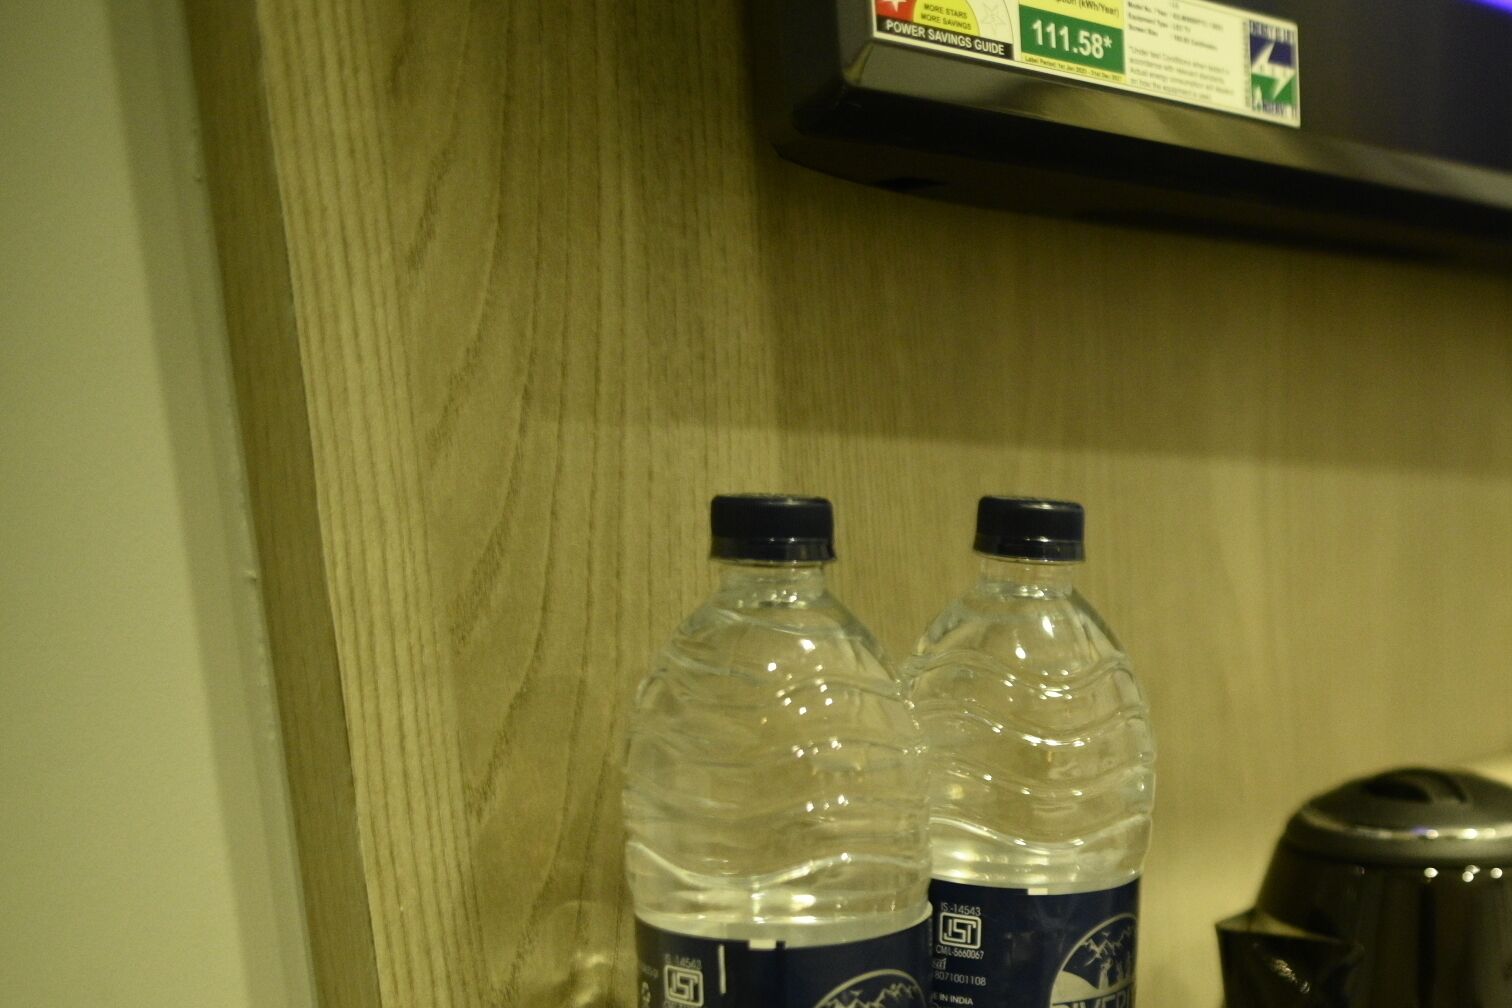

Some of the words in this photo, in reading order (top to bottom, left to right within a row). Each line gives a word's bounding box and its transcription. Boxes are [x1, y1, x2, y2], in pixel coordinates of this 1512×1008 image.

[924, 3, 944, 15] MORE
[946, 8, 967, 19] STARS
[921, 13, 941, 23] MORE
[943, 17, 972, 30] SAVINGS
[886, 20, 925, 38] POWER
[927, 28, 972, 48] SAVINGS
[974, 39, 1005, 56] GUIDE
[939, 992, 949, 1001] IN
[950, 995, 974, 1006] INDIA
